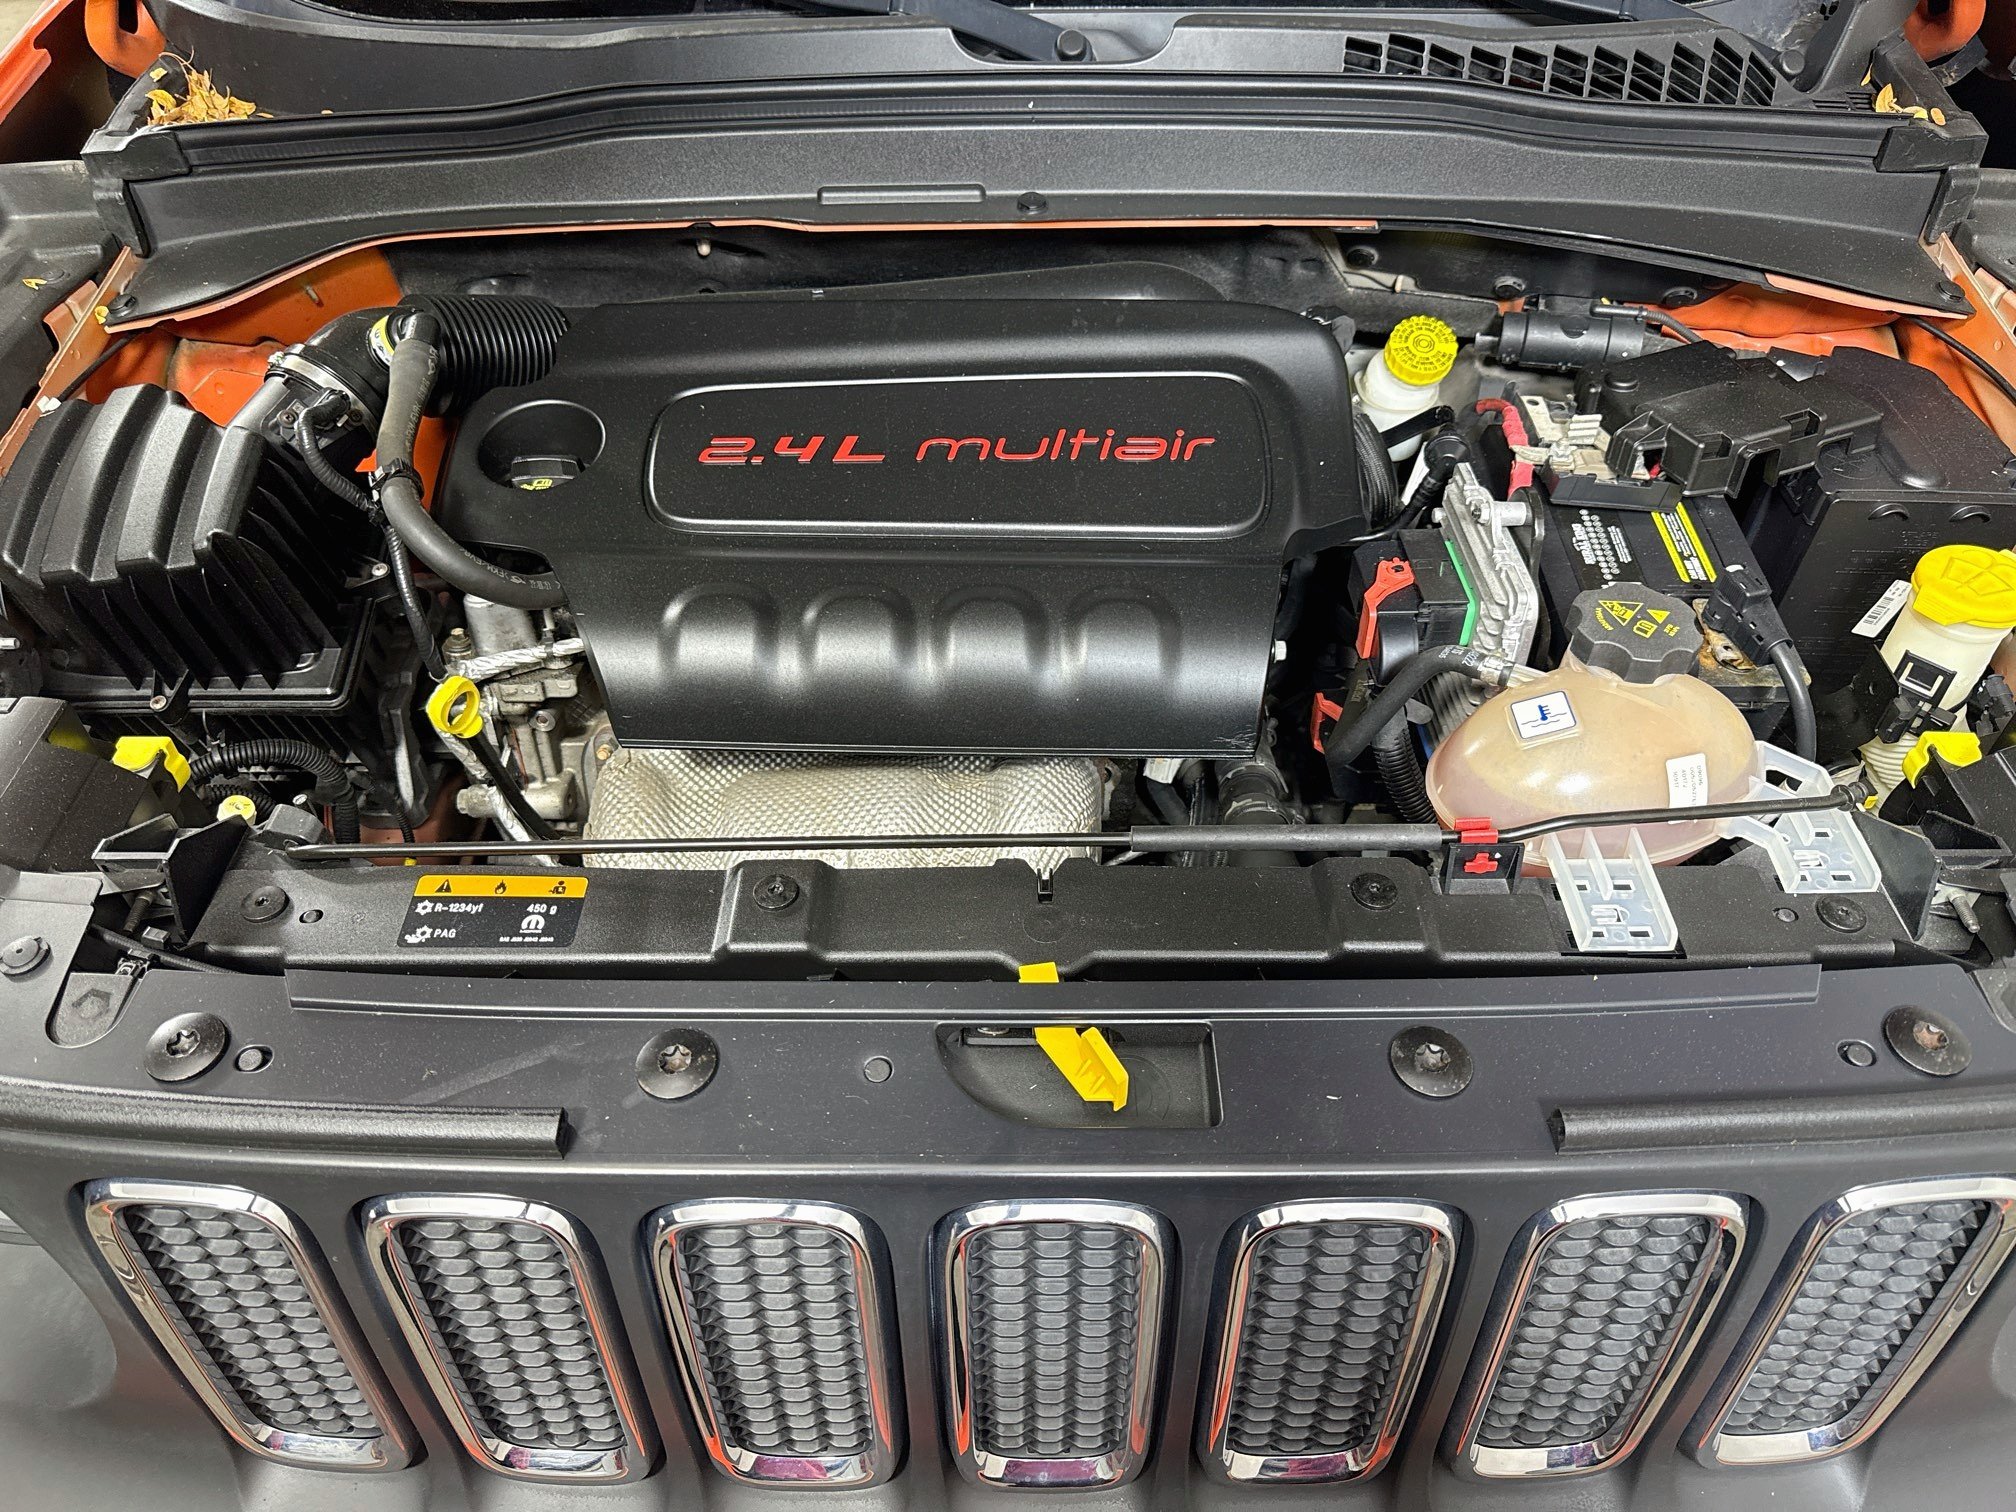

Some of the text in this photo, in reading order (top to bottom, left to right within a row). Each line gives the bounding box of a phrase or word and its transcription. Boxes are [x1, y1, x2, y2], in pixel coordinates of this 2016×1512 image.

[915, 428, 1217, 463] multiair
[434, 902, 484, 914] R-1234yf
[526, 903, 558, 915] 450 g
[433, 928, 457, 939] PAG
